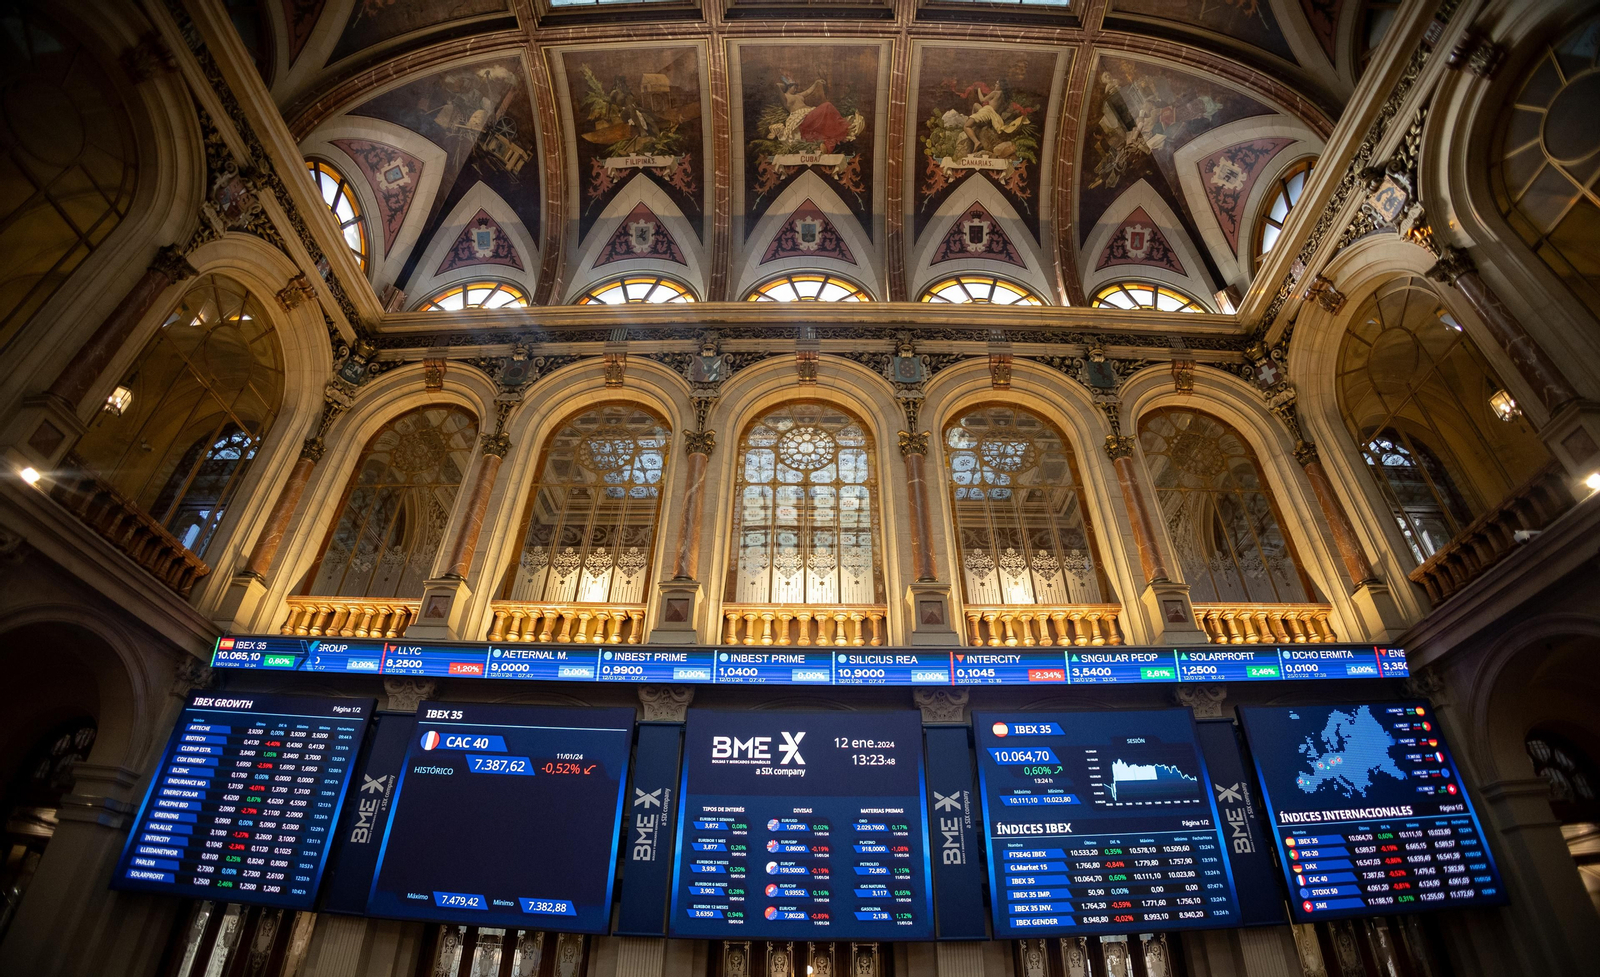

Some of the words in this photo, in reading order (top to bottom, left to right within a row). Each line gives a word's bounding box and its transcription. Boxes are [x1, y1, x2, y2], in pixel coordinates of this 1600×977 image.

[236, 641, 255, 649] IBEX
[398, 647, 422, 655] LLYC
[503, 650, 554, 659] AETERNAL
[1292, 651, 1319, 660] DCHO
[218, 652, 260, 661] 10.065,10
[615, 653, 651, 661] INBEST
[849, 656, 893, 664] SILICIUS
[896, 656, 918, 664] REA
[967, 655, 1021, 664] INTERCITY
[1082, 654, 1128, 663] SNGULAR
[1190, 652, 1254, 661] SOLARPROFIT
[386, 660, 422, 668] 8,2500
[491, 663, 529, 672] 9,0000
[1286, 664, 1318, 673] 0,0100
[603, 666, 642, 675] 0,9900
[719, 668, 757, 676] 1,0400
[838, 669, 884, 678] 10,9000
[957, 669, 995, 678] 0,1045
[1072, 668, 1111, 677] 3,5400
[1182, 666, 1217, 675] 1,2500
[193, 698, 213, 708] IBEX
[214, 699, 253, 709] GROWTH
[333, 705, 350, 714] Página
[426, 710, 449, 719] IBEX
[451, 711, 463, 719] 35
[1015, 726, 1037, 734] IBEX
[446, 737, 471, 748] CAC
[473, 738, 489, 749] 40
[712, 736, 771, 758] BME
[834, 738, 848, 748] 12
[852, 754, 895, 766] 13:23:48
[995, 751, 1049, 762] 10.064,70
[475, 759, 525, 772] 7.387,62
[542, 763, 581, 774] -0,52%
[414, 766, 453, 775] HISTÓRICO
[774, 768, 805, 776] company
[1024, 766, 1051, 775] 0,60%
[385, 775, 395, 797] company
[1280, 811, 1320, 823] ÍNDICES
[1322, 806, 1413, 820] INTERNACIONALES
[350, 799, 377, 843] BME
[996, 824, 1043, 834] ÍNDICES
[1045, 823, 1072, 833] IBEX
[1226, 808, 1251, 854] BME
[633, 814, 655, 861] BME
[941, 817, 961, 864] BME
[140, 846, 178, 856] LLEIDANETWOR
[135, 858, 155, 867] PARLEM
[130, 870, 164, 880] SOLARPROFIT
[407, 892, 428, 900] Máximo
[442, 895, 478, 906] 7.479,42
[528, 902, 567, 913] 7.382,88
